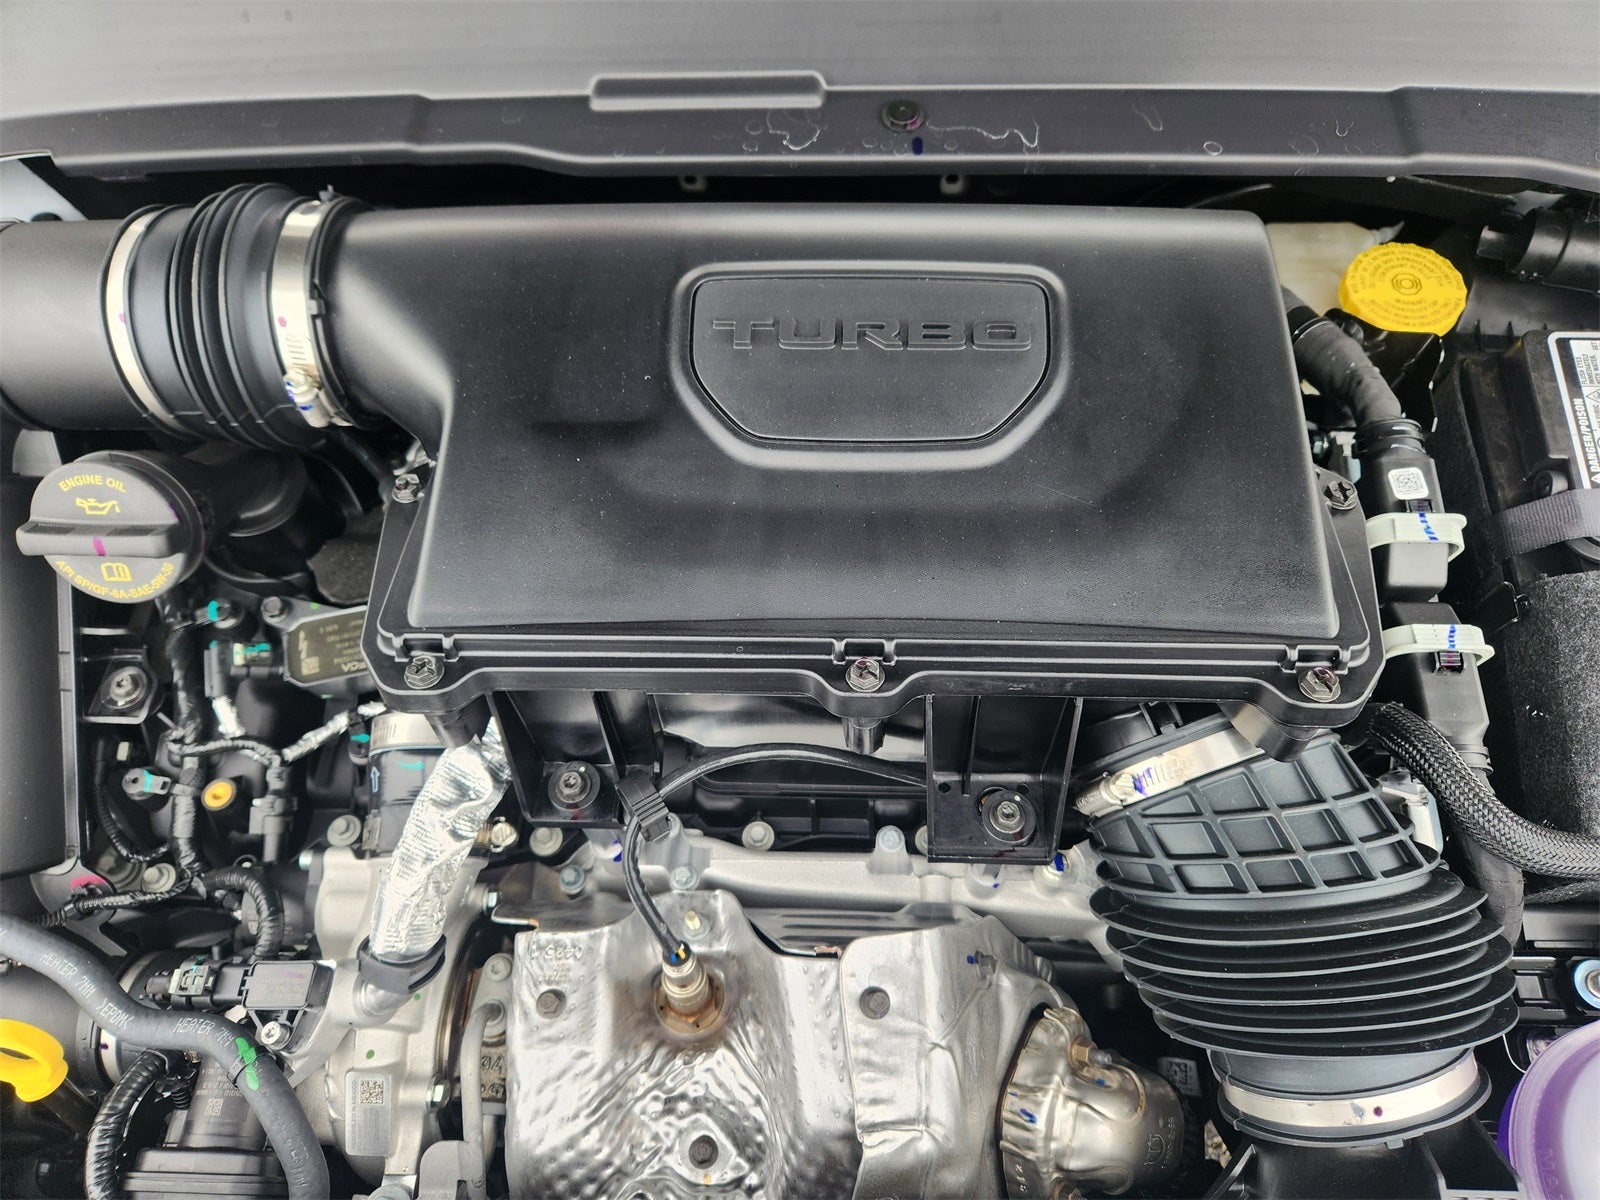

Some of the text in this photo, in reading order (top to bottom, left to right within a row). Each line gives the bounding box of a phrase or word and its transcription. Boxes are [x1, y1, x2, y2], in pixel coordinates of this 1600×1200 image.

[713, 320, 1032, 350] TURBO
[1573, 398, 1600, 473] DANGER/POISON
[58, 474, 127, 493] ENGINE OIL
[55, 560, 75, 578] API
[40, 951, 78, 981] HEATER
[172, 1017, 216, 1035] HEATER
